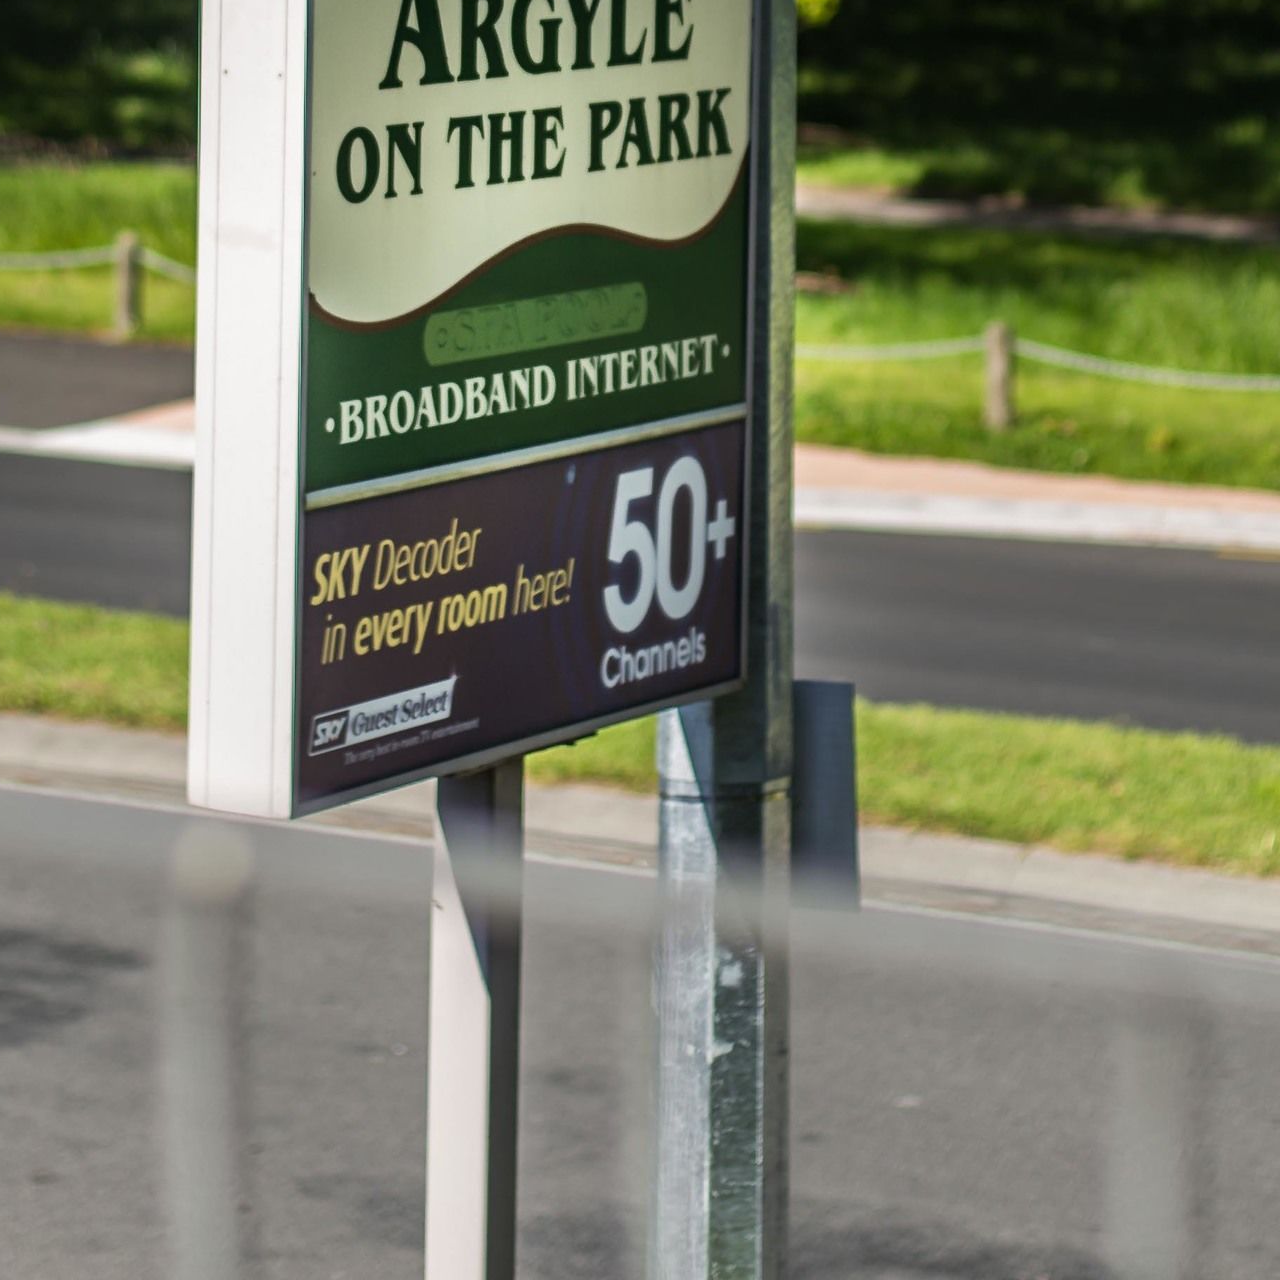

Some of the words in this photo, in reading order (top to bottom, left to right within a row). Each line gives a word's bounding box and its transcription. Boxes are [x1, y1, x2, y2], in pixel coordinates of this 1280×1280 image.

[335, 121, 425, 204] ON
[447, 106, 567, 189] THE
[587, 87, 732, 173] PARK
[338, 364, 557, 445] BROADBAND
[566, 333, 719, 401] INTERNET
[310, 543, 371, 606] SKY
[373, 517, 482, 591] Decoder
[603, 455, 736, 634] 50+
[321, 614, 347, 665] in
[353, 600, 434, 655] every
[437, 583, 508, 635] room
[512, 557, 576, 616] here!
[600, 625, 707, 689] Channels
[351, 704, 398, 737] Guest
[401, 690, 448, 723] Select
